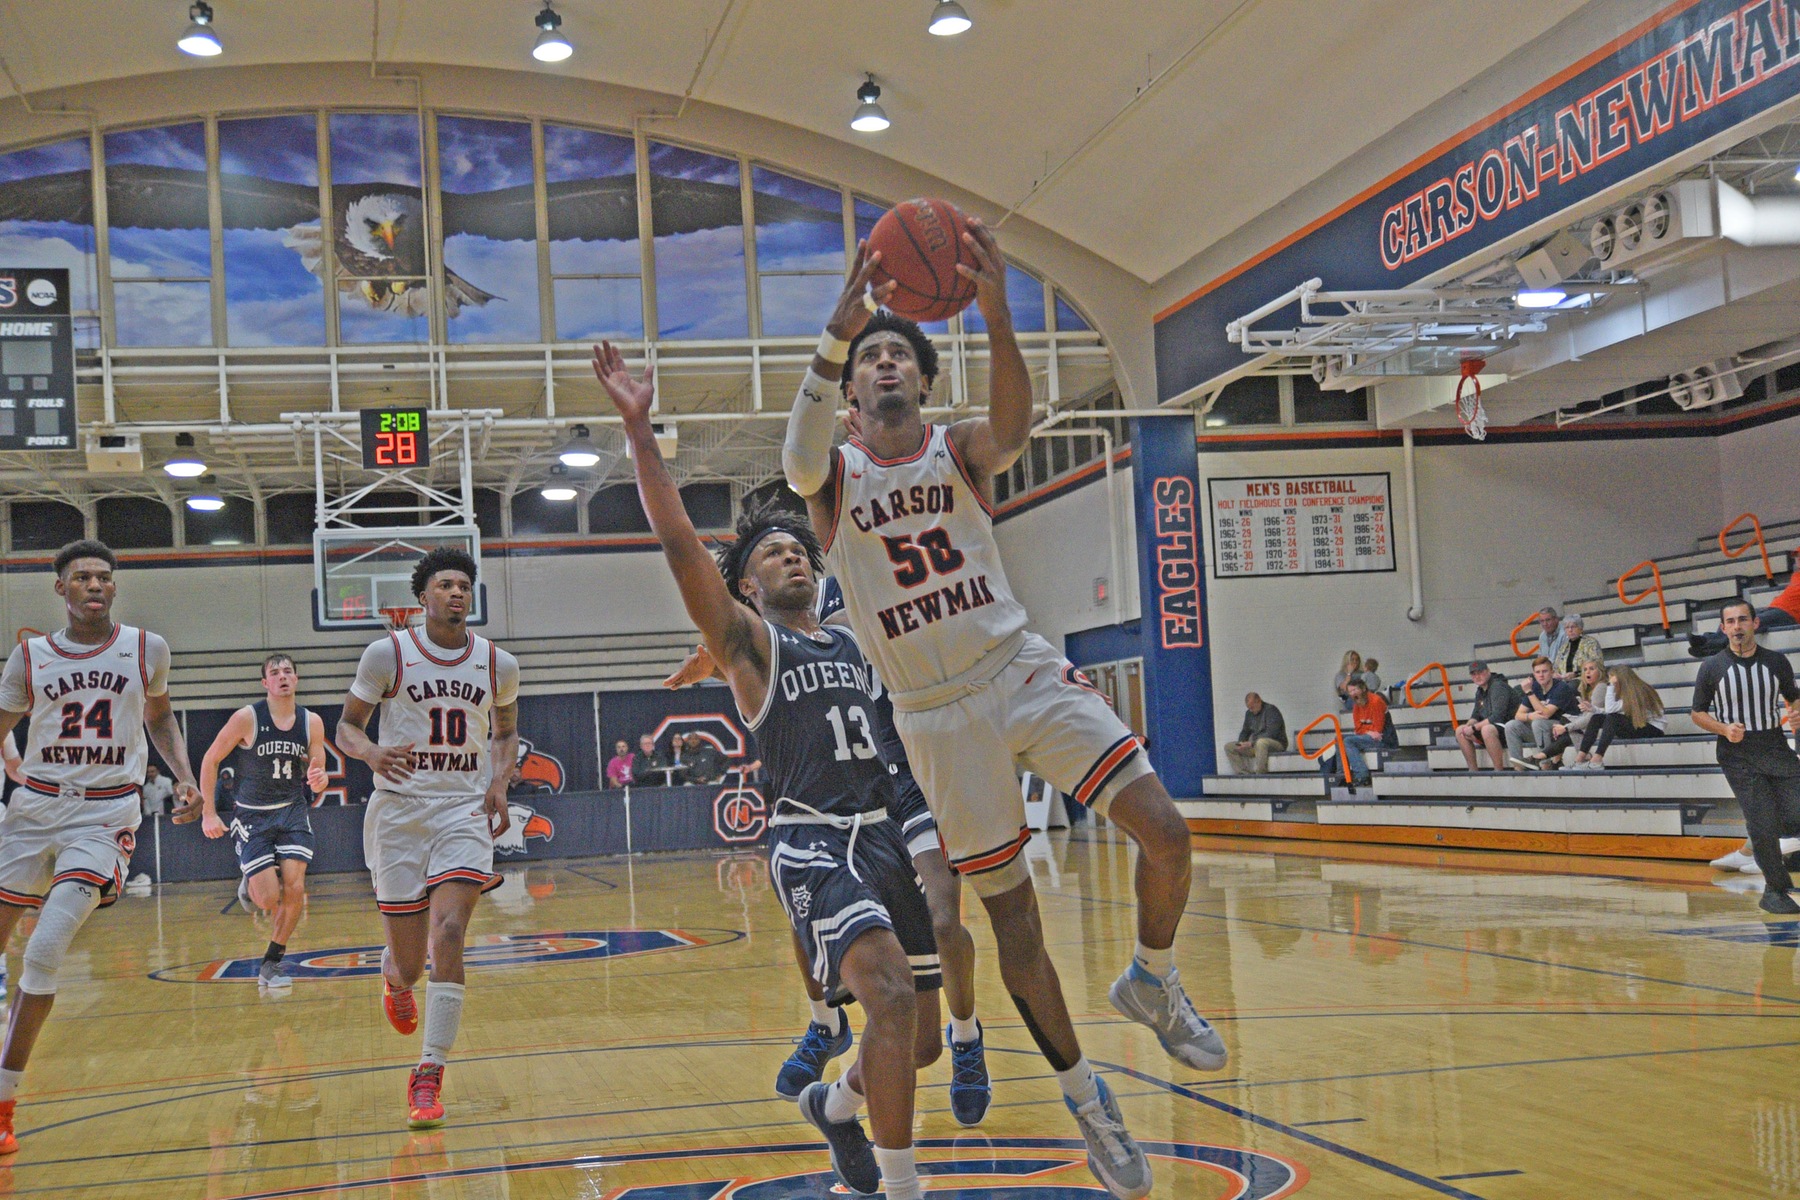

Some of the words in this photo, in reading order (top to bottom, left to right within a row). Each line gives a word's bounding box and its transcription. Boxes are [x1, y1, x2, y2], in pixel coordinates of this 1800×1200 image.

[0, 322, 52, 336] HOME
[28, 398, 64, 408] FOULS
[380, 413, 420, 431] 2:08
[27, 436, 68, 446] POINTS
[375, 432, 417, 464] 28
[1247, 482, 1280, 496] MEN'S
[1286, 480, 1356, 495] BASKETBALL
[850, 484, 954, 532] CARSON
[1217, 500, 1234, 509] HOLT
[1239, 498, 1281, 508] FIELDHOUSE
[1285, 498, 1297, 507] ERA
[1302, 496, 1345, 507] CONFERENCE
[1348, 495, 1385, 505] CHAMPIONS
[880, 526, 966, 590] 50
[1153, 475, 1203, 649] EAGLES
[43, 670, 129, 701] CARSON
[407, 679, 486, 706] CARSON
[58, 699, 113, 739] 24
[429, 707, 467, 747] 10
[825, 705, 878, 761] 13
[41, 746, 126, 765] NEWMAN
[272, 758, 292, 779] 14
